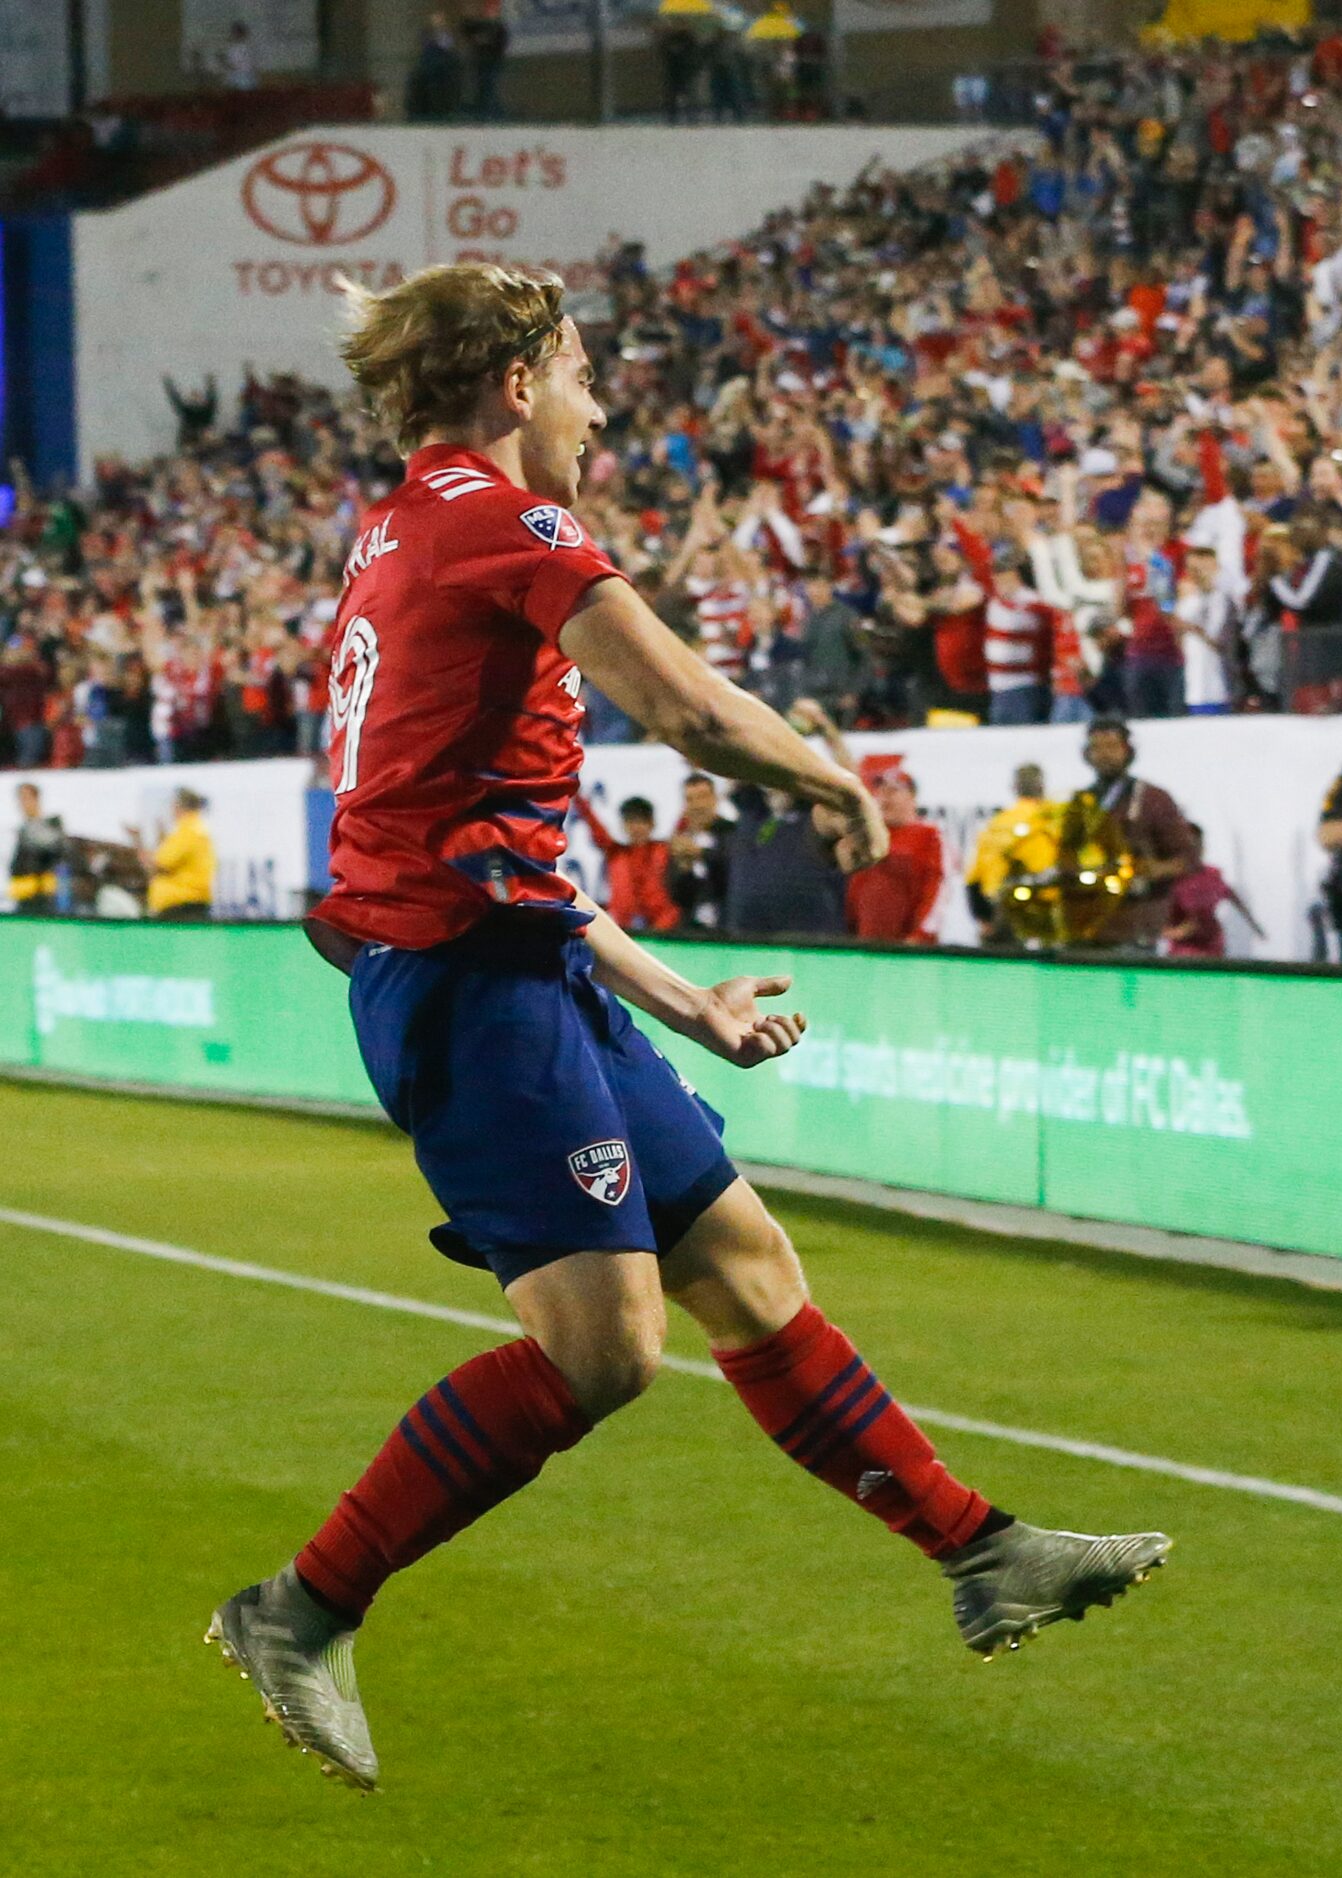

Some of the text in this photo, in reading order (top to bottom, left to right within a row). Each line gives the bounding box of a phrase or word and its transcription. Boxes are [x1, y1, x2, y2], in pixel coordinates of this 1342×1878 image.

[450, 145, 567, 189] Let's
[446, 196, 519, 240] Go
[526, 509, 555, 524] MLS
[342, 507, 399, 587] KAL
[1102, 1050, 1128, 1125] of
[1131, 1054, 1167, 1131] FC
[573, 1144, 625, 1171] FC DALLAS
